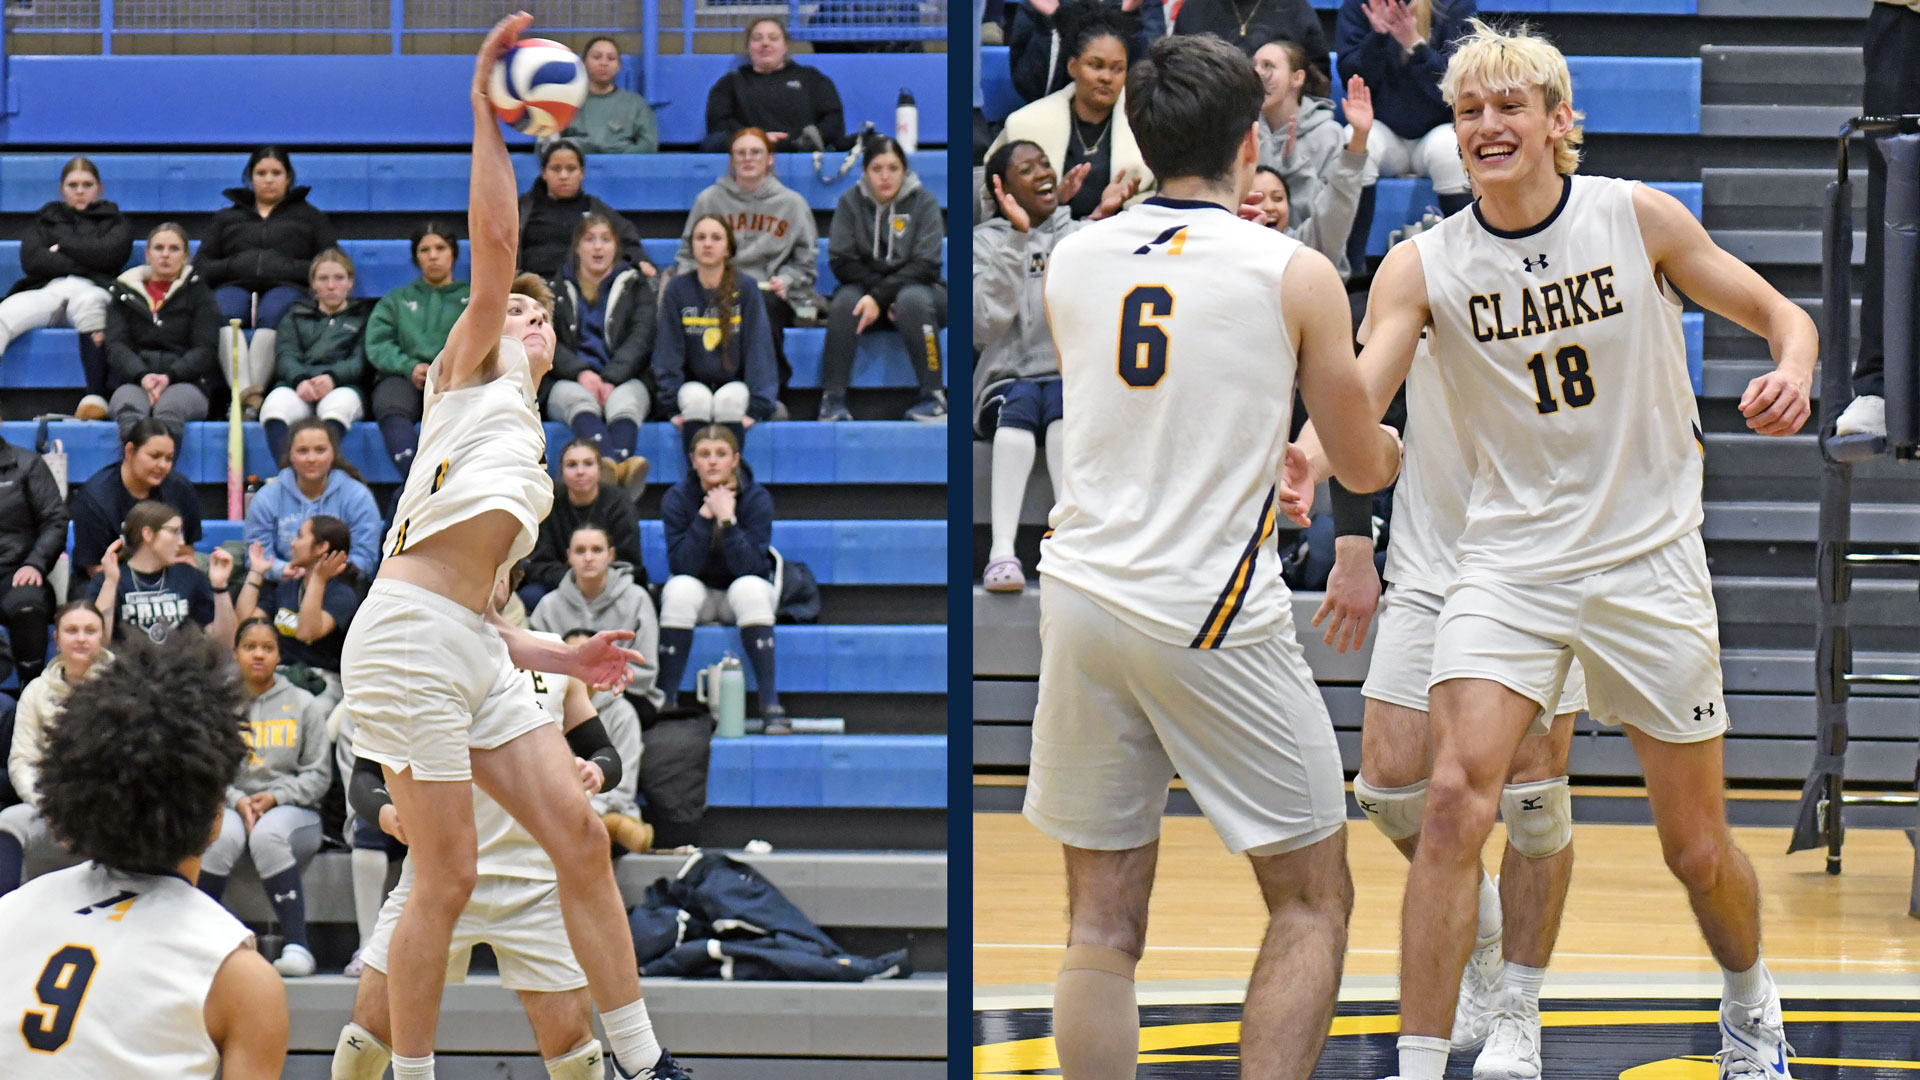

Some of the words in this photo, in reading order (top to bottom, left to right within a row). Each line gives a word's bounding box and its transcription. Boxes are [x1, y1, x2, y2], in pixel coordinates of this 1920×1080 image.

[728, 211, 789, 238] IANTS
[1116, 283, 1176, 390] 6
[1468, 264, 1624, 343] CLARKE
[1526, 343, 1597, 415] 18
[122, 599, 188, 620] PRIDE
[19, 942, 100, 1055] 9
